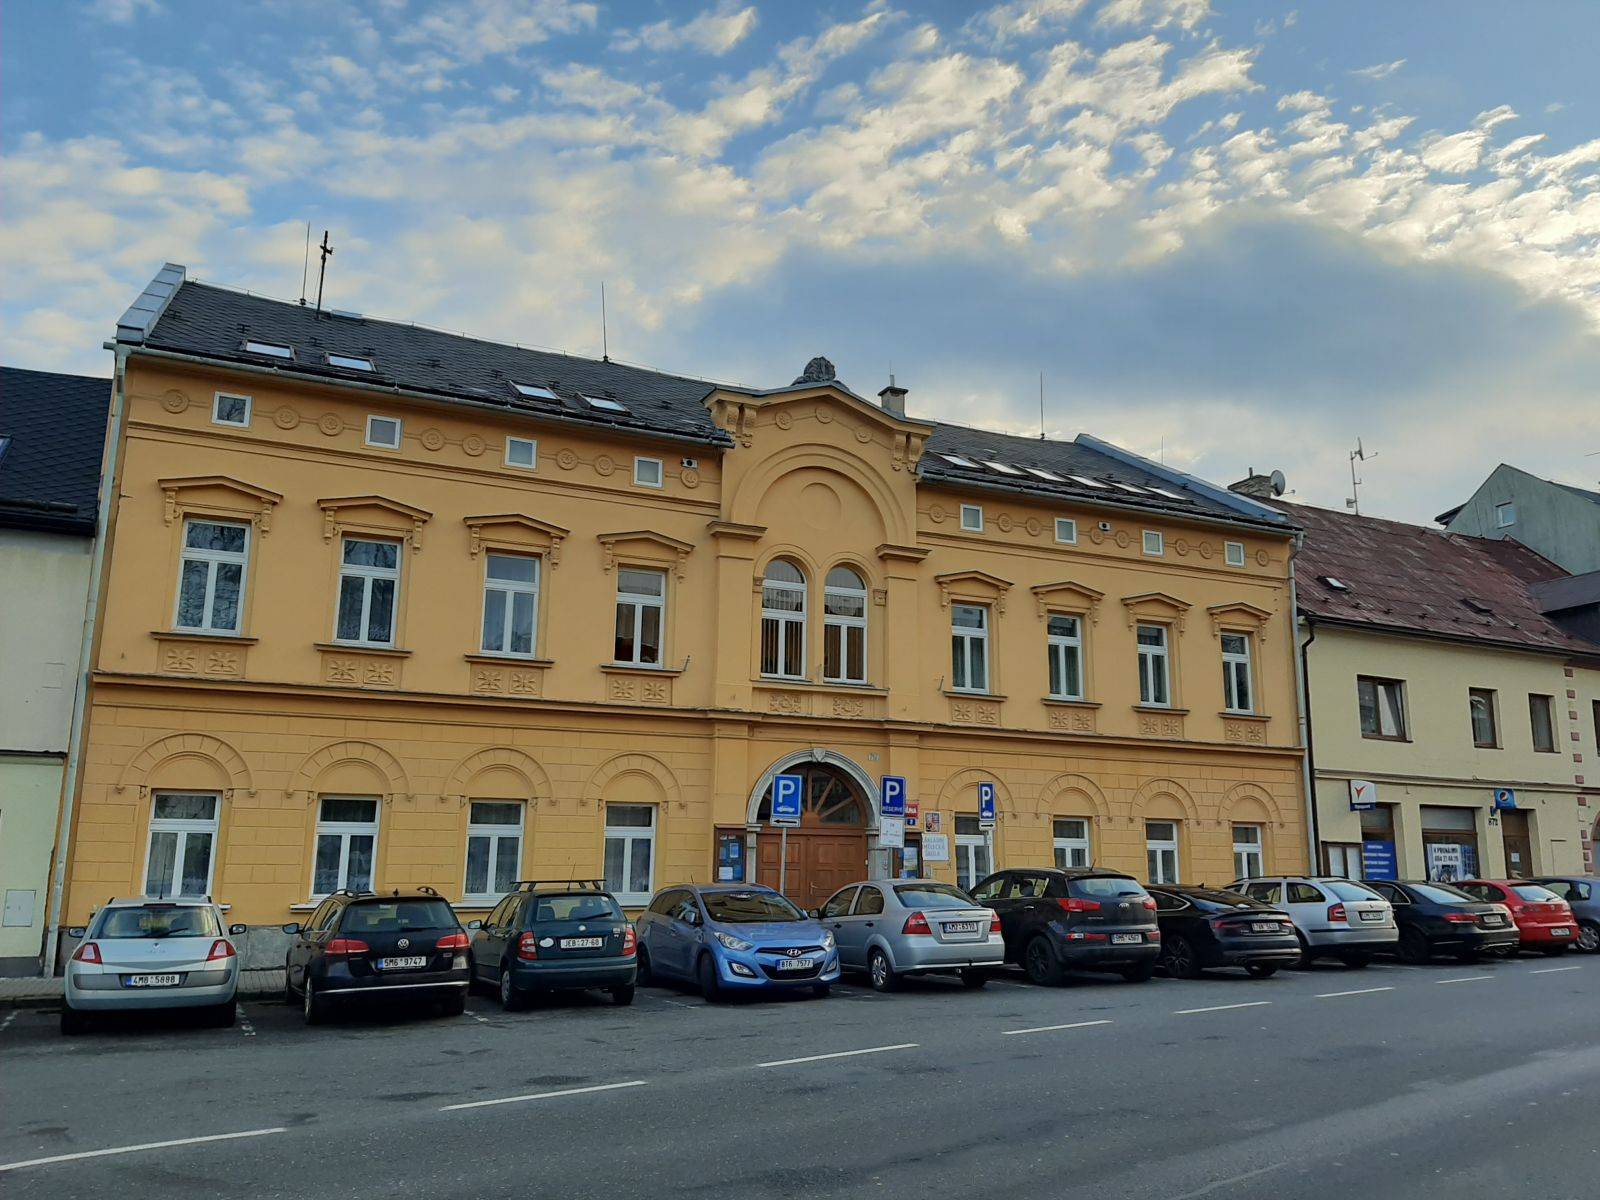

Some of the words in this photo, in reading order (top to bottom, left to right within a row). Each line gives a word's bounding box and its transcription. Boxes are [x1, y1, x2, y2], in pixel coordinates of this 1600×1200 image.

[778, 779, 795, 803] P
[885, 780, 900, 804] P
[981, 786, 991, 808] P
[384, 958, 399, 967] 5M6
[404, 957, 423, 966] 9747
